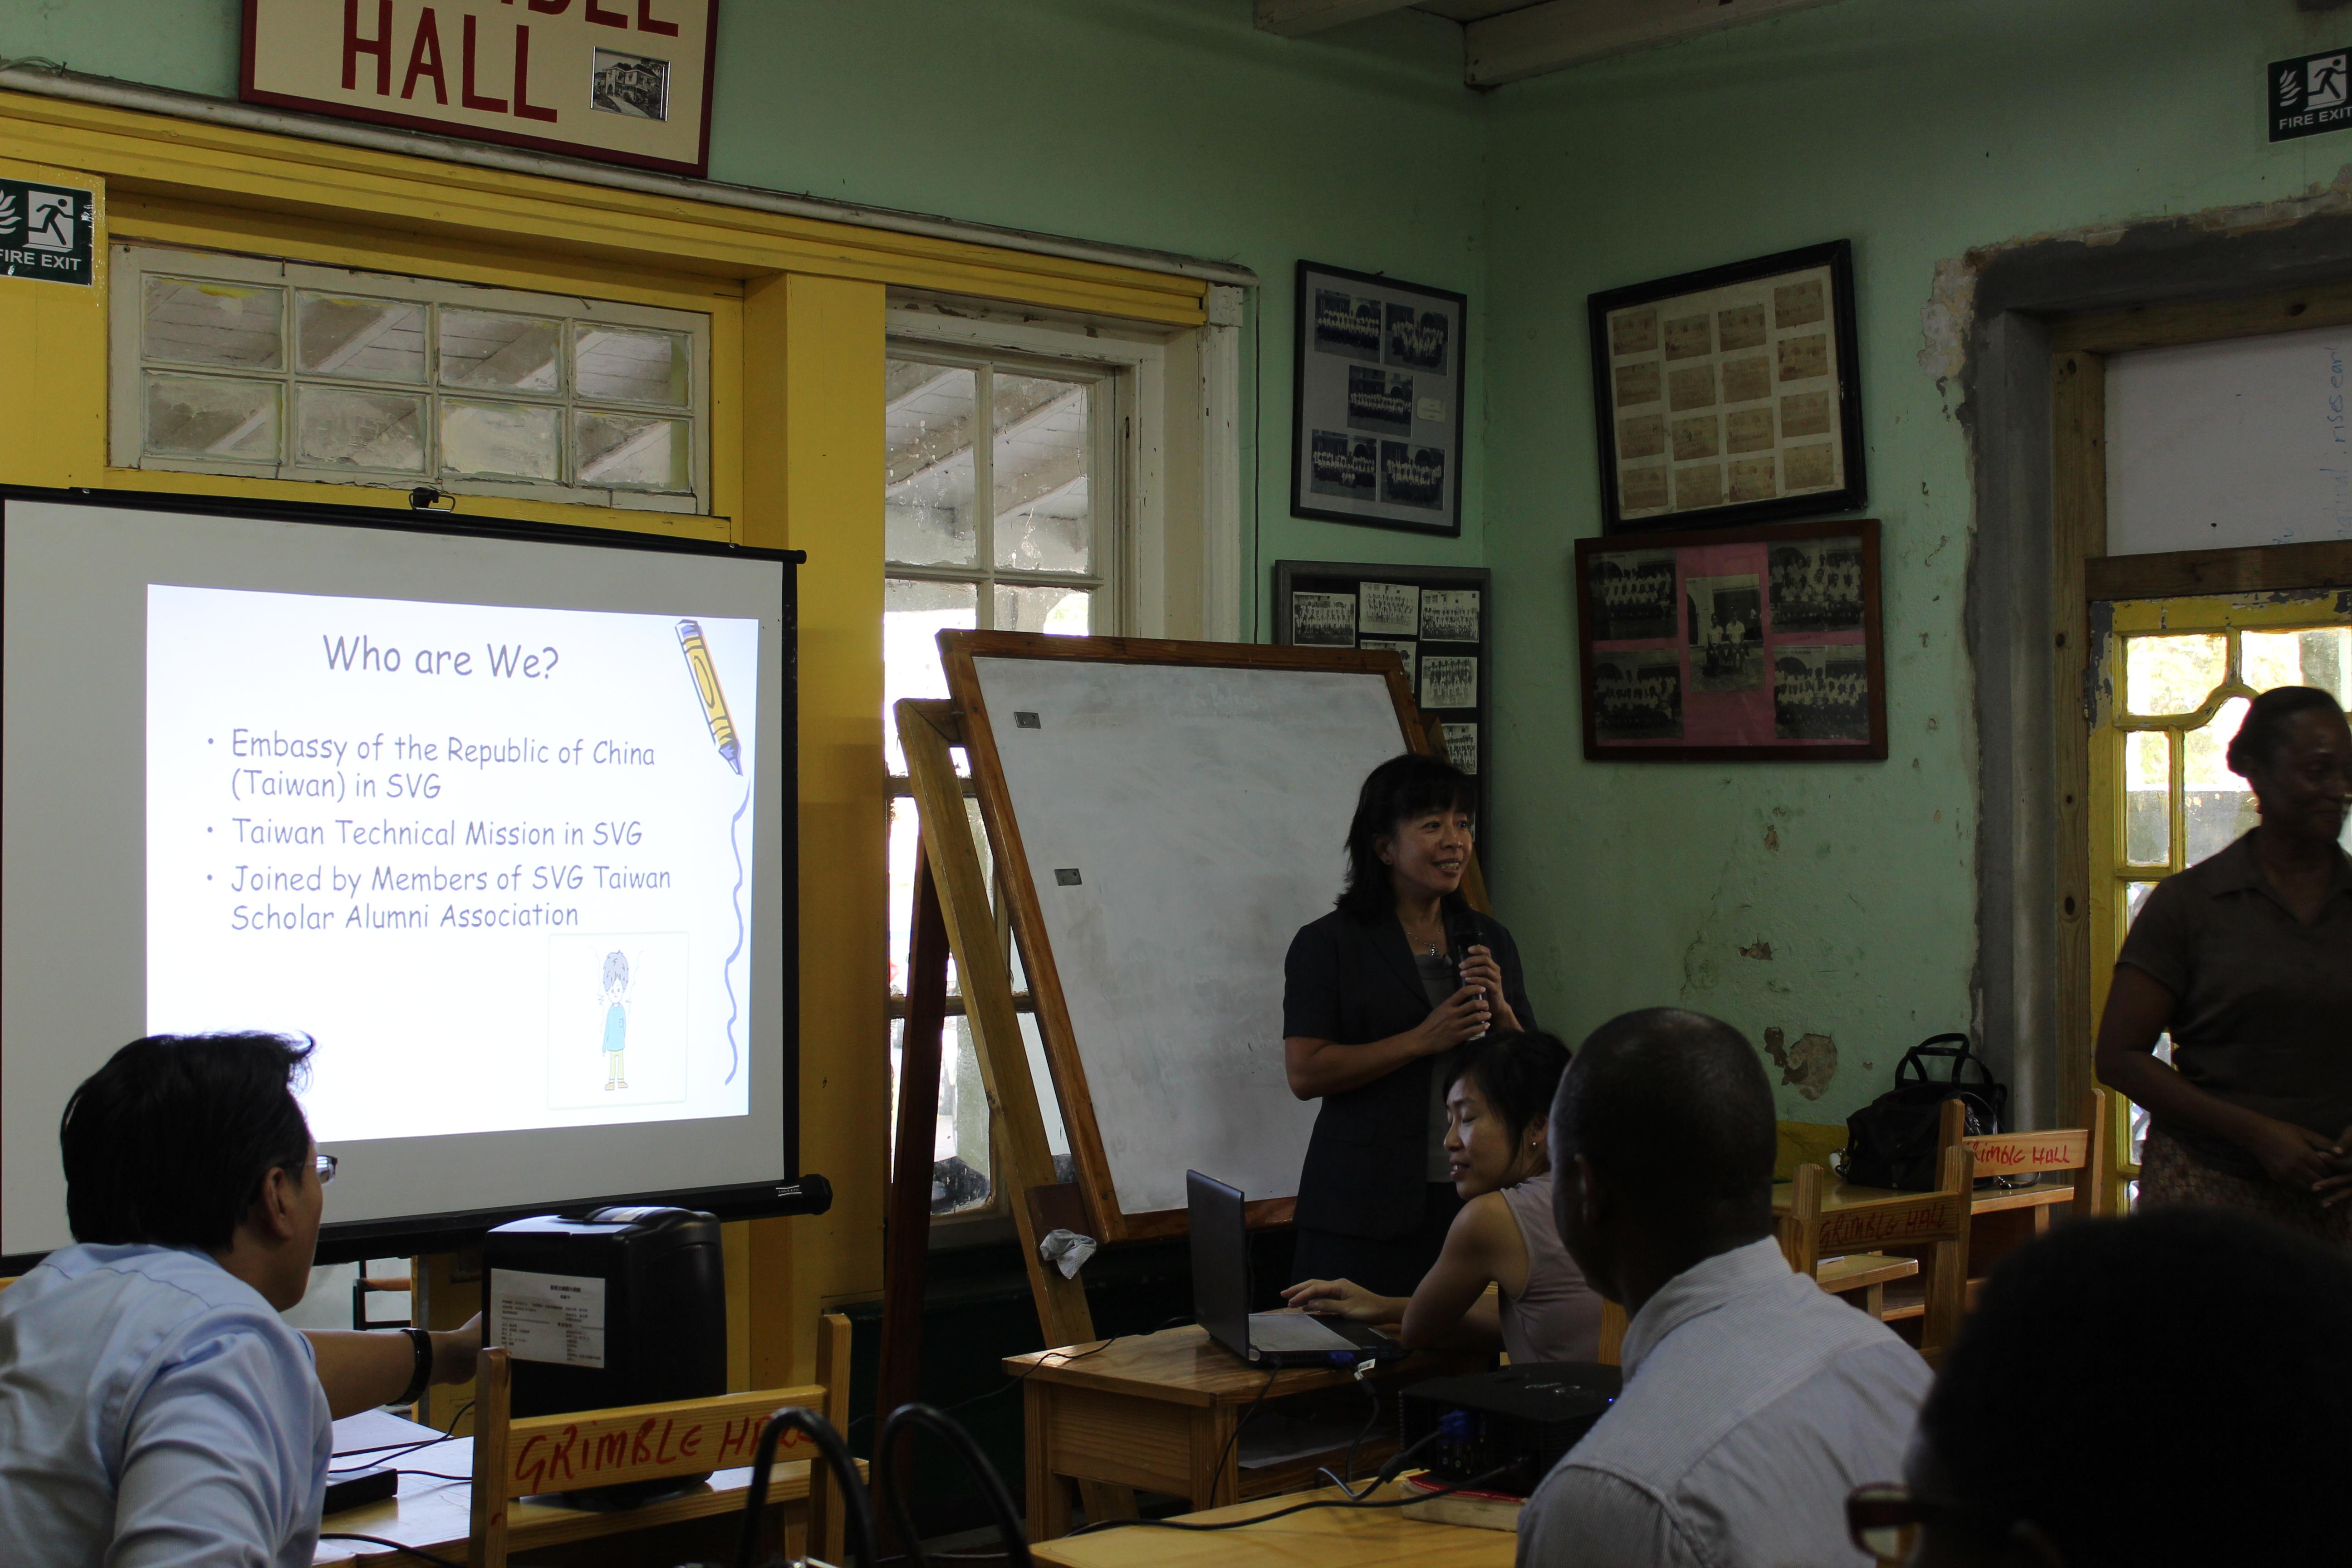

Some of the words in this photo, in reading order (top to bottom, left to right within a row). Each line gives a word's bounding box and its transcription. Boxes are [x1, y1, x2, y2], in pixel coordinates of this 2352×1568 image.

[342, 0, 557, 123] HALL
[2279, 114, 2313, 130] FIRE
[2319, 107, 2352, 122] EXIT
[41, 254, 82, 271] EXIT
[2327, 395, 2345, 443] rises
[323, 635, 401, 672] Who
[416, 650, 472, 676] are
[487, 643, 559, 679] We?
[233, 729, 348, 767] Embassy
[358, 733, 384, 761] of
[395, 734, 438, 761] the
[449, 737, 549, 770] Republic
[559, 739, 583, 765] of
[593, 740, 654, 765] China
[232, 768, 345, 803] (Taiwan)
[357, 773, 375, 797] in
[387, 773, 441, 799] SVG
[232, 818, 323, 844] Taiwan
[335, 819, 454, 845] Technical
[466, 821, 554, 845] Mission
[565, 822, 583, 845] in
[593, 821, 642, 845] SVG
[231, 865, 321, 892] Joined
[333, 866, 361, 899] by
[372, 866, 487, 891] Members
[497, 865, 522, 891] of
[533, 865, 583, 889] SVG
[593, 866, 670, 889] Taiwan
[232, 904, 334, 930] Scholar
[346, 904, 428, 929] Alumni
[440, 902, 578, 927] Association
[1905, 1202, 1946, 1235] HALL
